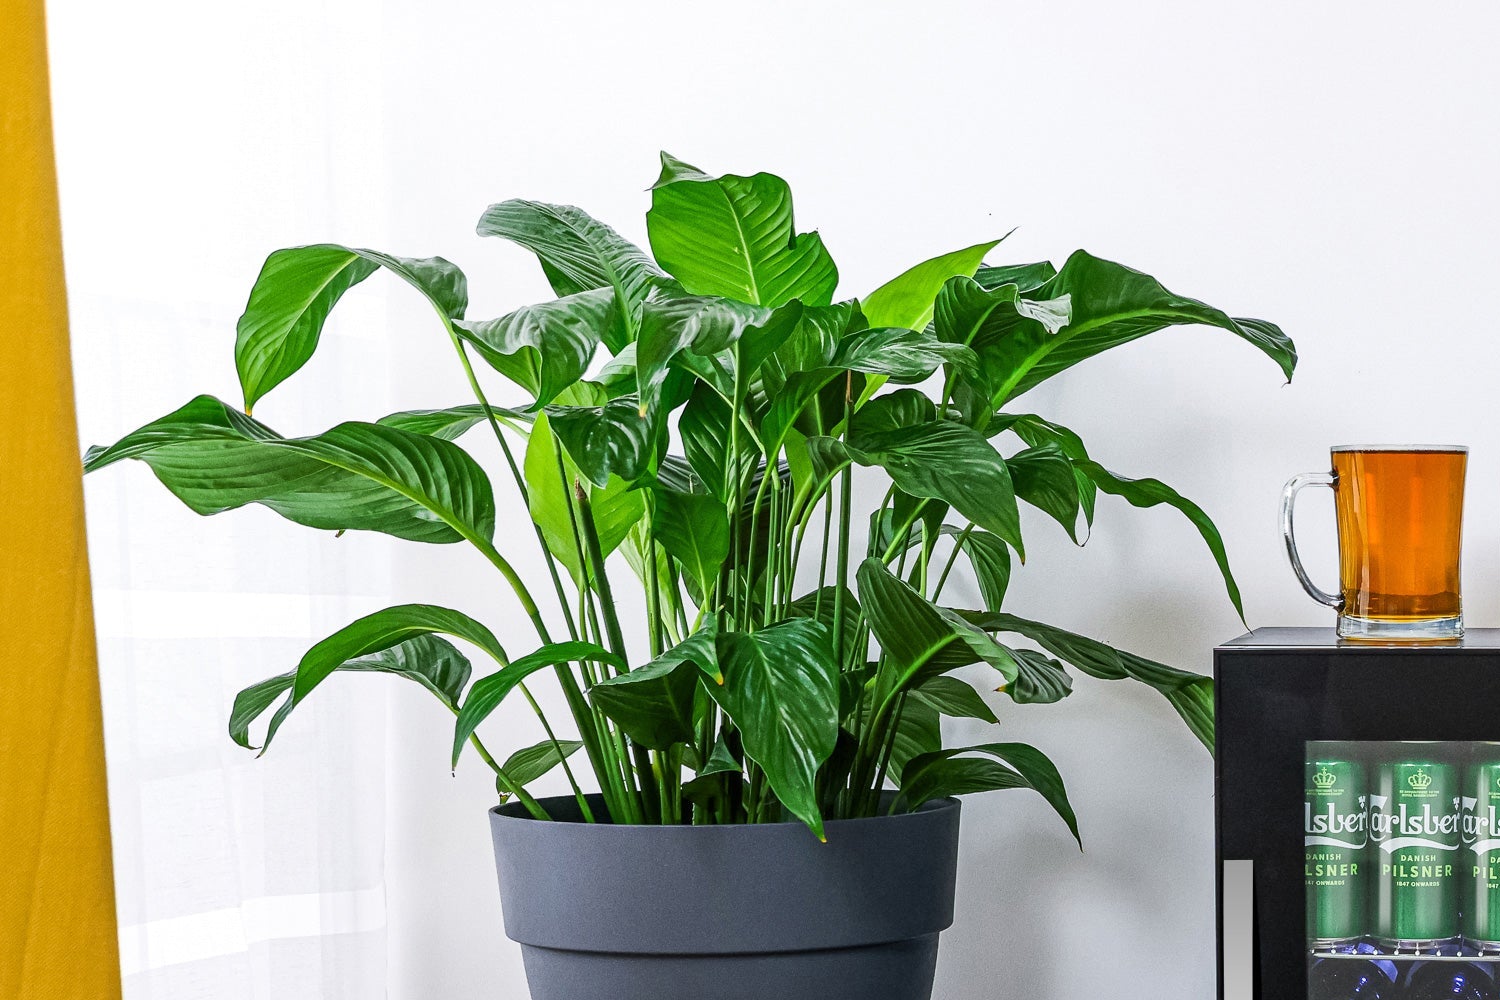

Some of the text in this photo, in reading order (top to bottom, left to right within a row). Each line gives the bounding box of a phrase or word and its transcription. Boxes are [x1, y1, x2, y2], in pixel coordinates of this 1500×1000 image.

[1304, 802, 1368, 834] lsber
[1369, 794, 1460, 842] Carlsber
[1305, 853, 1342, 861] DANISH
[1400, 854, 1436, 862] DANISH
[1304, 863, 1358, 877] LSNER
[1382, 863, 1452, 878] PILSNER
